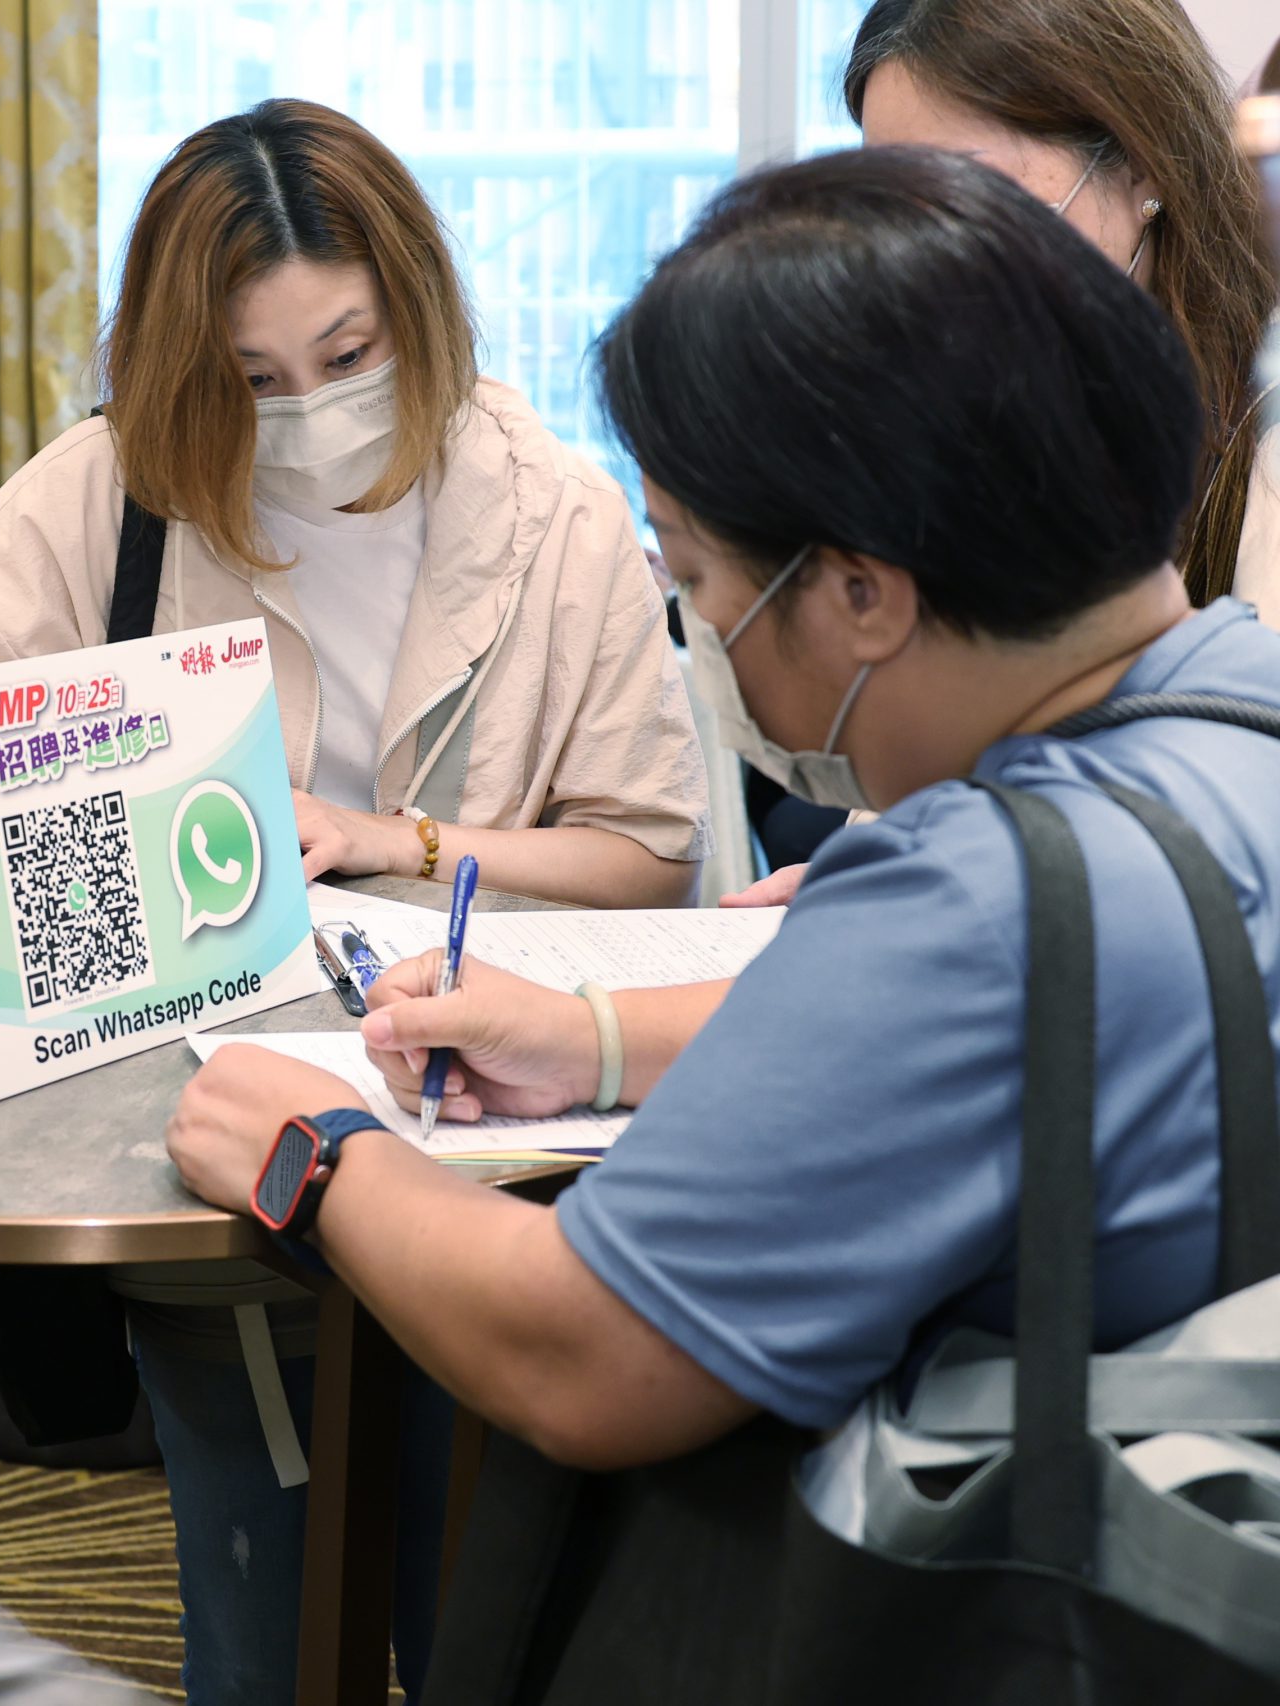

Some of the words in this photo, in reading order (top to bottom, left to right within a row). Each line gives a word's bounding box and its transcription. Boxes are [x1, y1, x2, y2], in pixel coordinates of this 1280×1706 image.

[221, 636, 263, 663] JUMP
[56, 677, 121, 716] 10月25日
[34, 1028, 91, 1063] Scan
[94, 991, 204, 1043] Whatsapp
[209, 970, 261, 1005] Code
